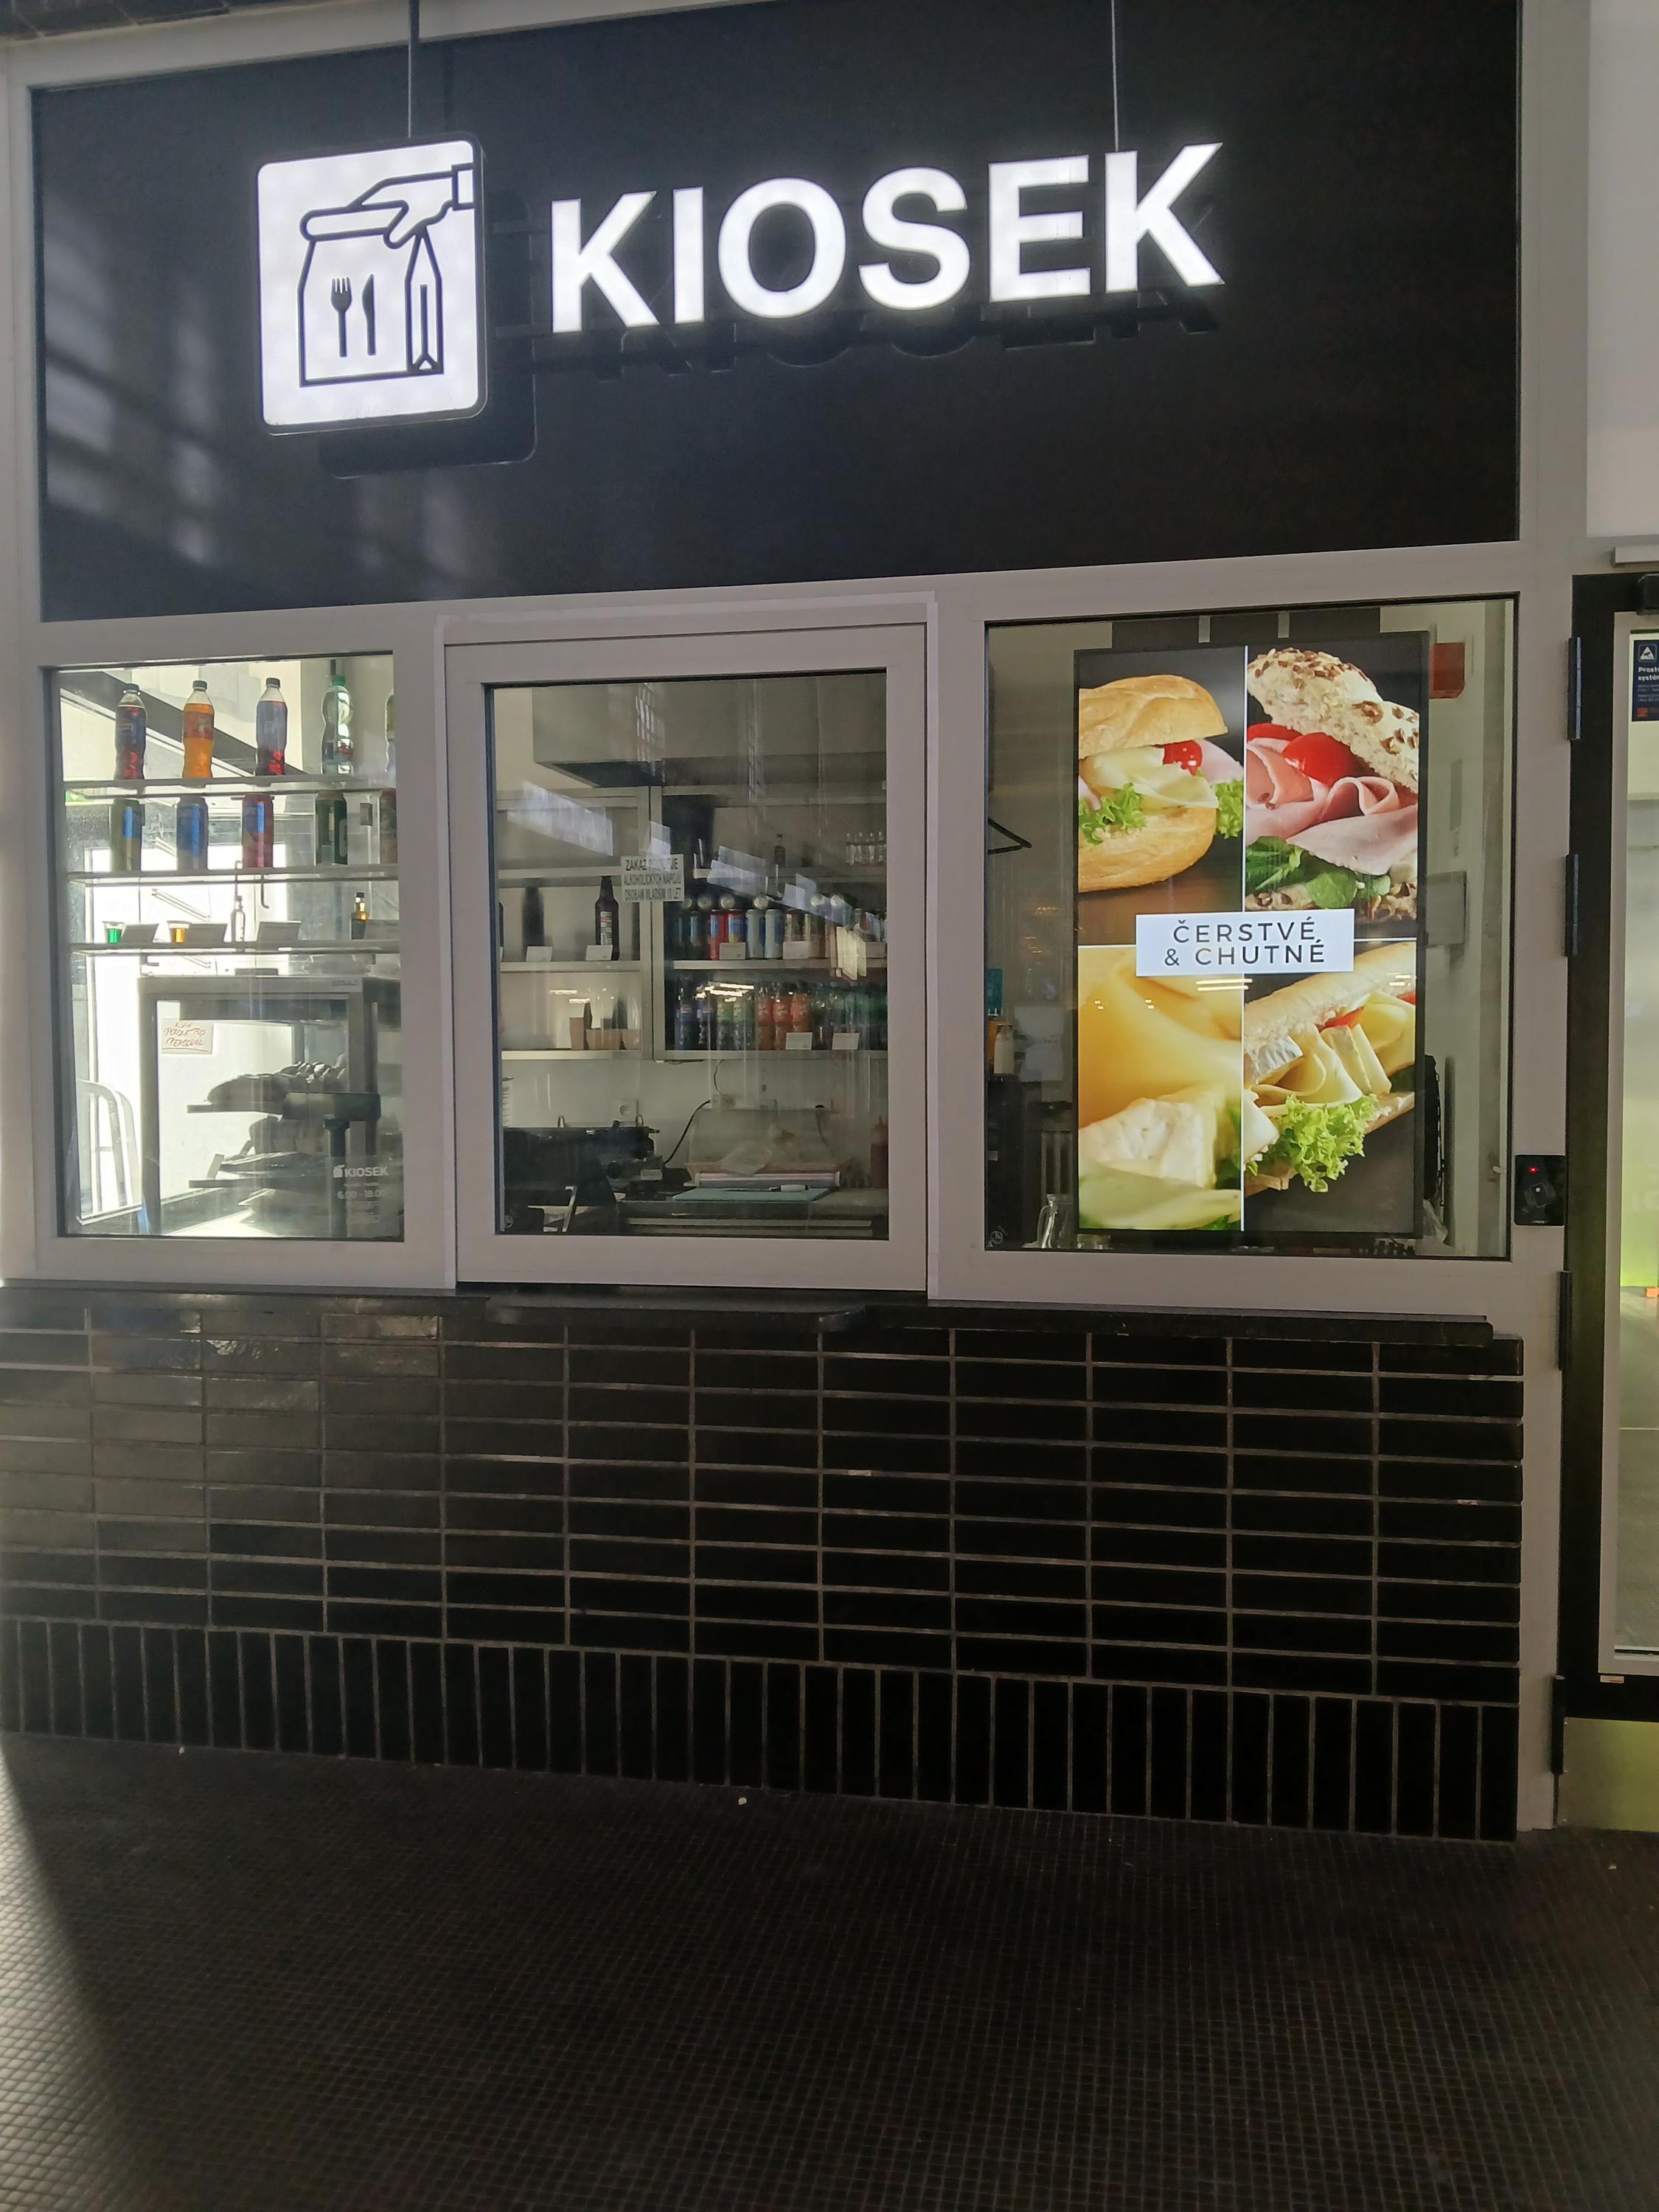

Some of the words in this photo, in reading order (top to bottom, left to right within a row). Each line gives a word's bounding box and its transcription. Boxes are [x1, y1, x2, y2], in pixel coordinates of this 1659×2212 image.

[549, 142, 1225, 335] KIOSEK
[1172, 916, 1315, 944] ČERSTVÉ
[1164, 948, 1180, 967] &
[1195, 939, 1325, 965] CHUTNÉ
[344, 1166, 389, 1178] KIOSEK
